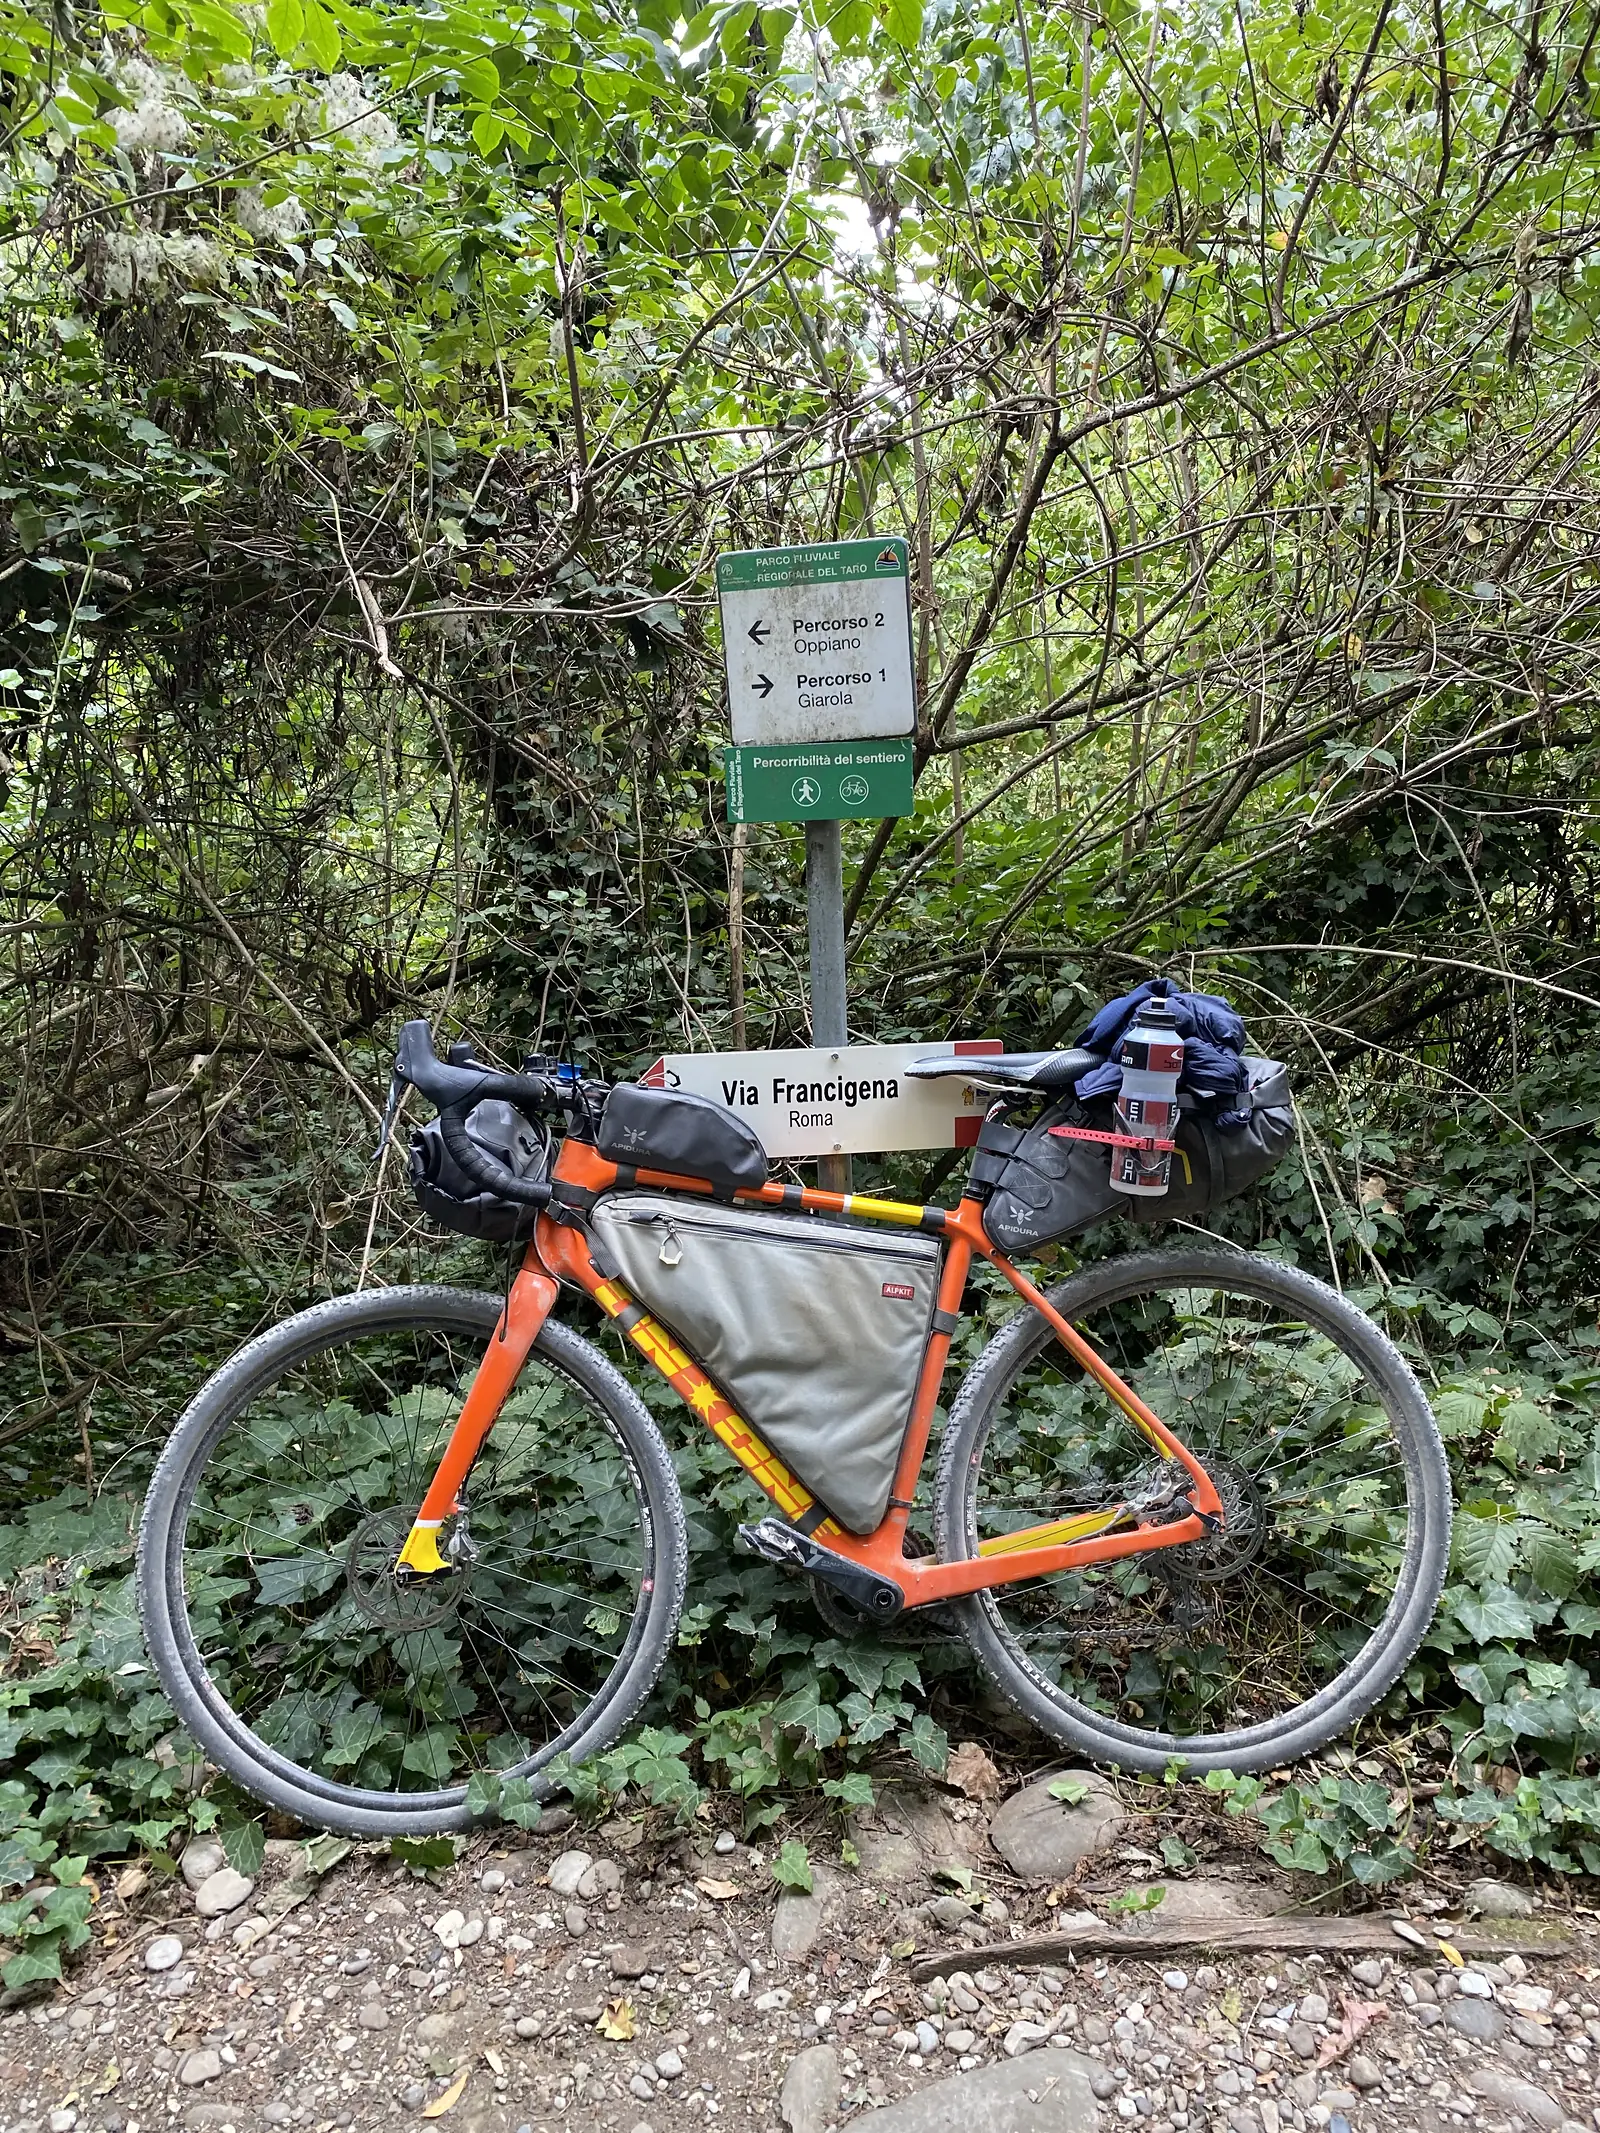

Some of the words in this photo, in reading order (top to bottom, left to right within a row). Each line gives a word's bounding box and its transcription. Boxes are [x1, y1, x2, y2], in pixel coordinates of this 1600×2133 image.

[756, 556, 790, 567] PARCO
[793, 551, 840, 563] FLUVIALE
[818, 567, 837, 577] DEL
[840, 564, 867, 574] TARO
[793, 617, 868, 634] Percorso
[874, 613, 885, 627] 2
[794, 637, 861, 656] Oppiano
[797, 672, 871, 688] Percorso
[879, 668, 886, 682] 1
[798, 691, 853, 708] Giarola
[753, 755, 831, 768] Percorribilità
[834, 754, 853, 765] del
[856, 752, 906, 764] sentiero
[721, 1080, 759, 1106] Via
[773, 1076, 899, 1108] Francigena
[789, 1111, 833, 1127] Roma
[611, 1142, 651, 1156] APIDURA
[997, 1223, 1039, 1237] APIDURA
[885, 1286, 911, 1296] ALPKIT
[645, 1517, 653, 1548] TUBELESS
